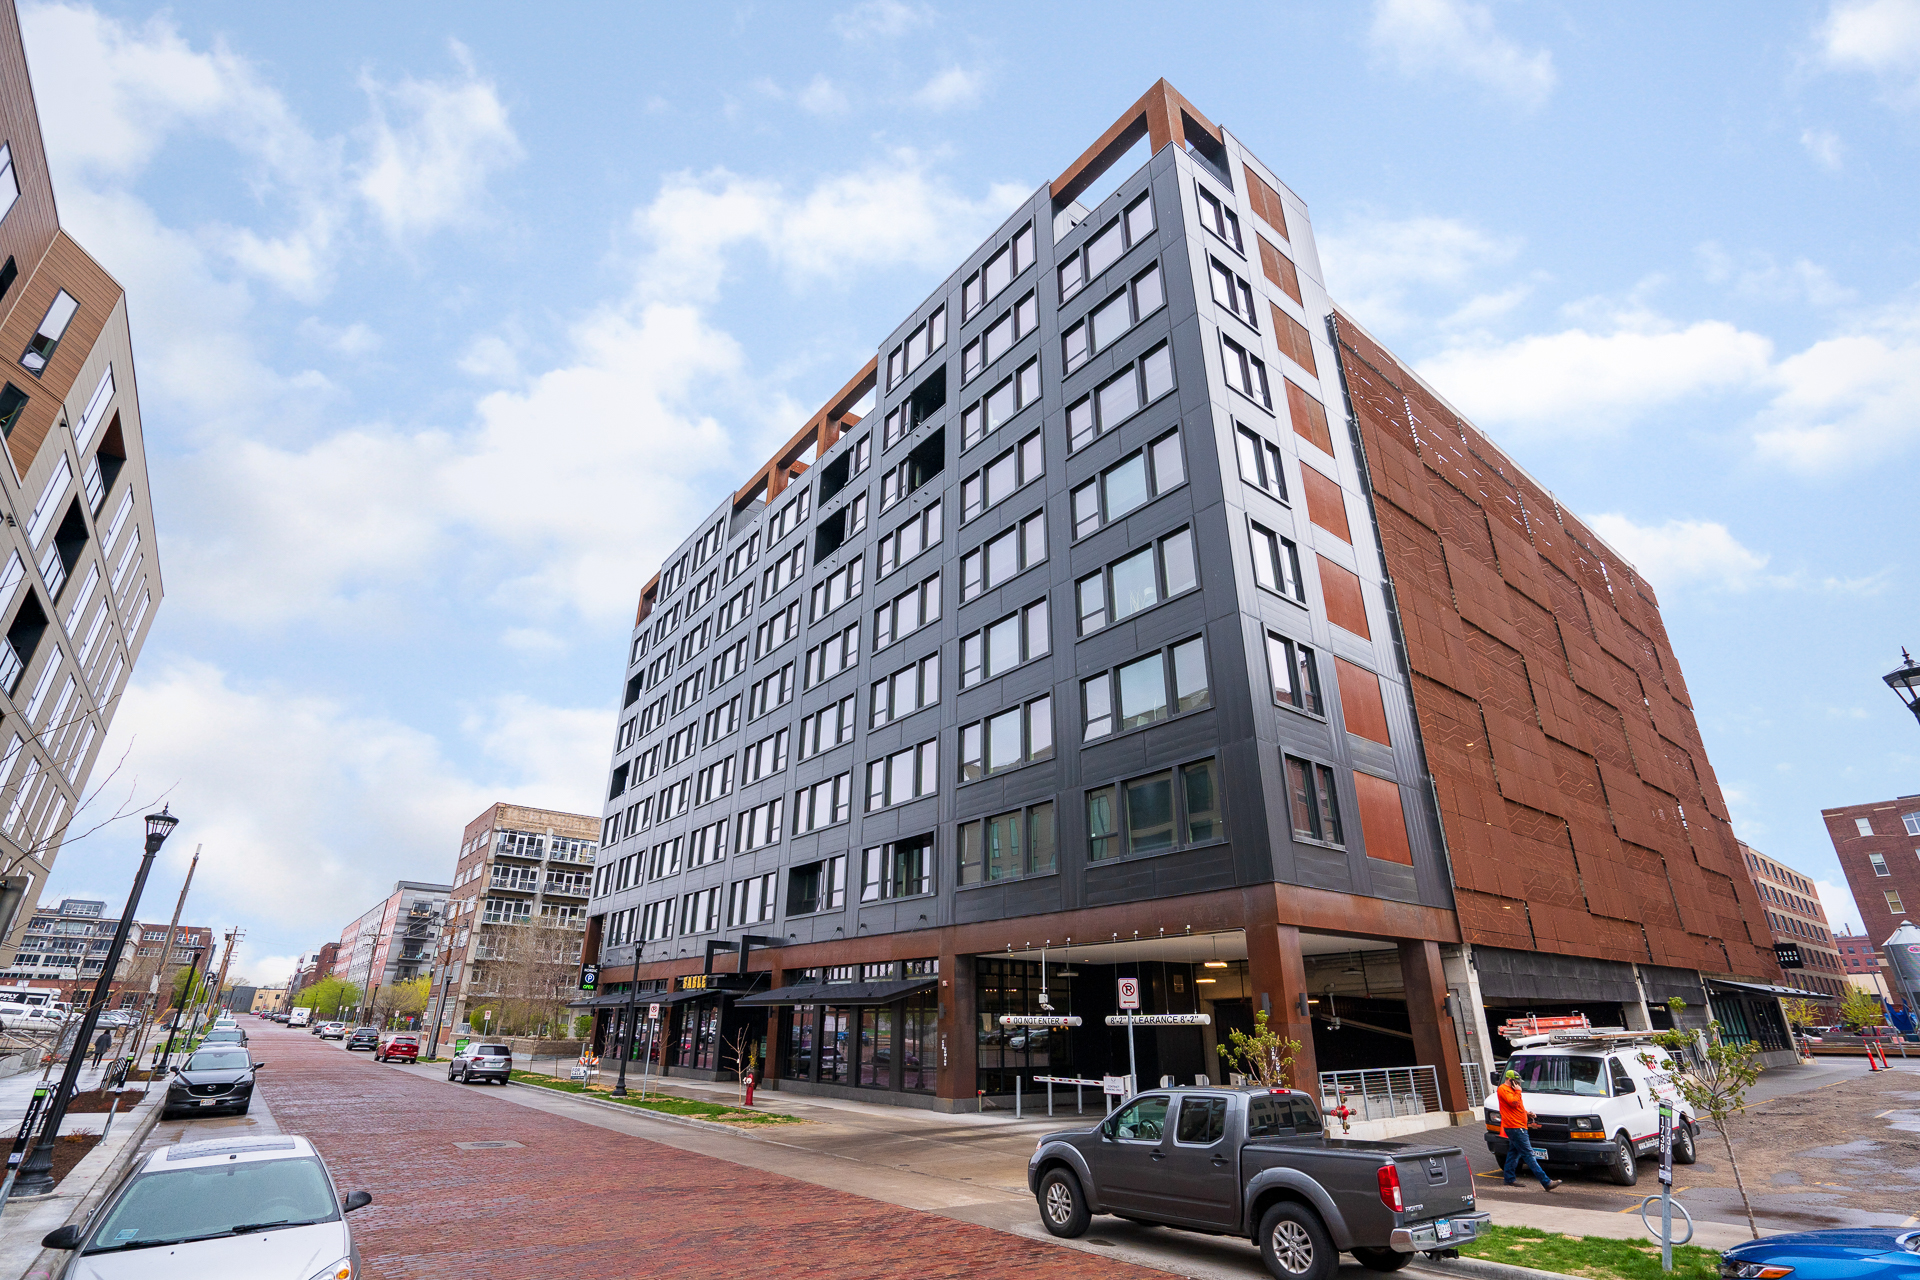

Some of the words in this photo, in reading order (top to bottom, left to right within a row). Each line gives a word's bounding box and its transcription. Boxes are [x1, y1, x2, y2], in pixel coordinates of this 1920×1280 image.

[682, 976, 706, 989] SABLE
[1038, 1017, 1059, 1025] ENTER
[20, 1100, 38, 1139] 1733
[1405, 1204, 1424, 1212] FRONTIER
